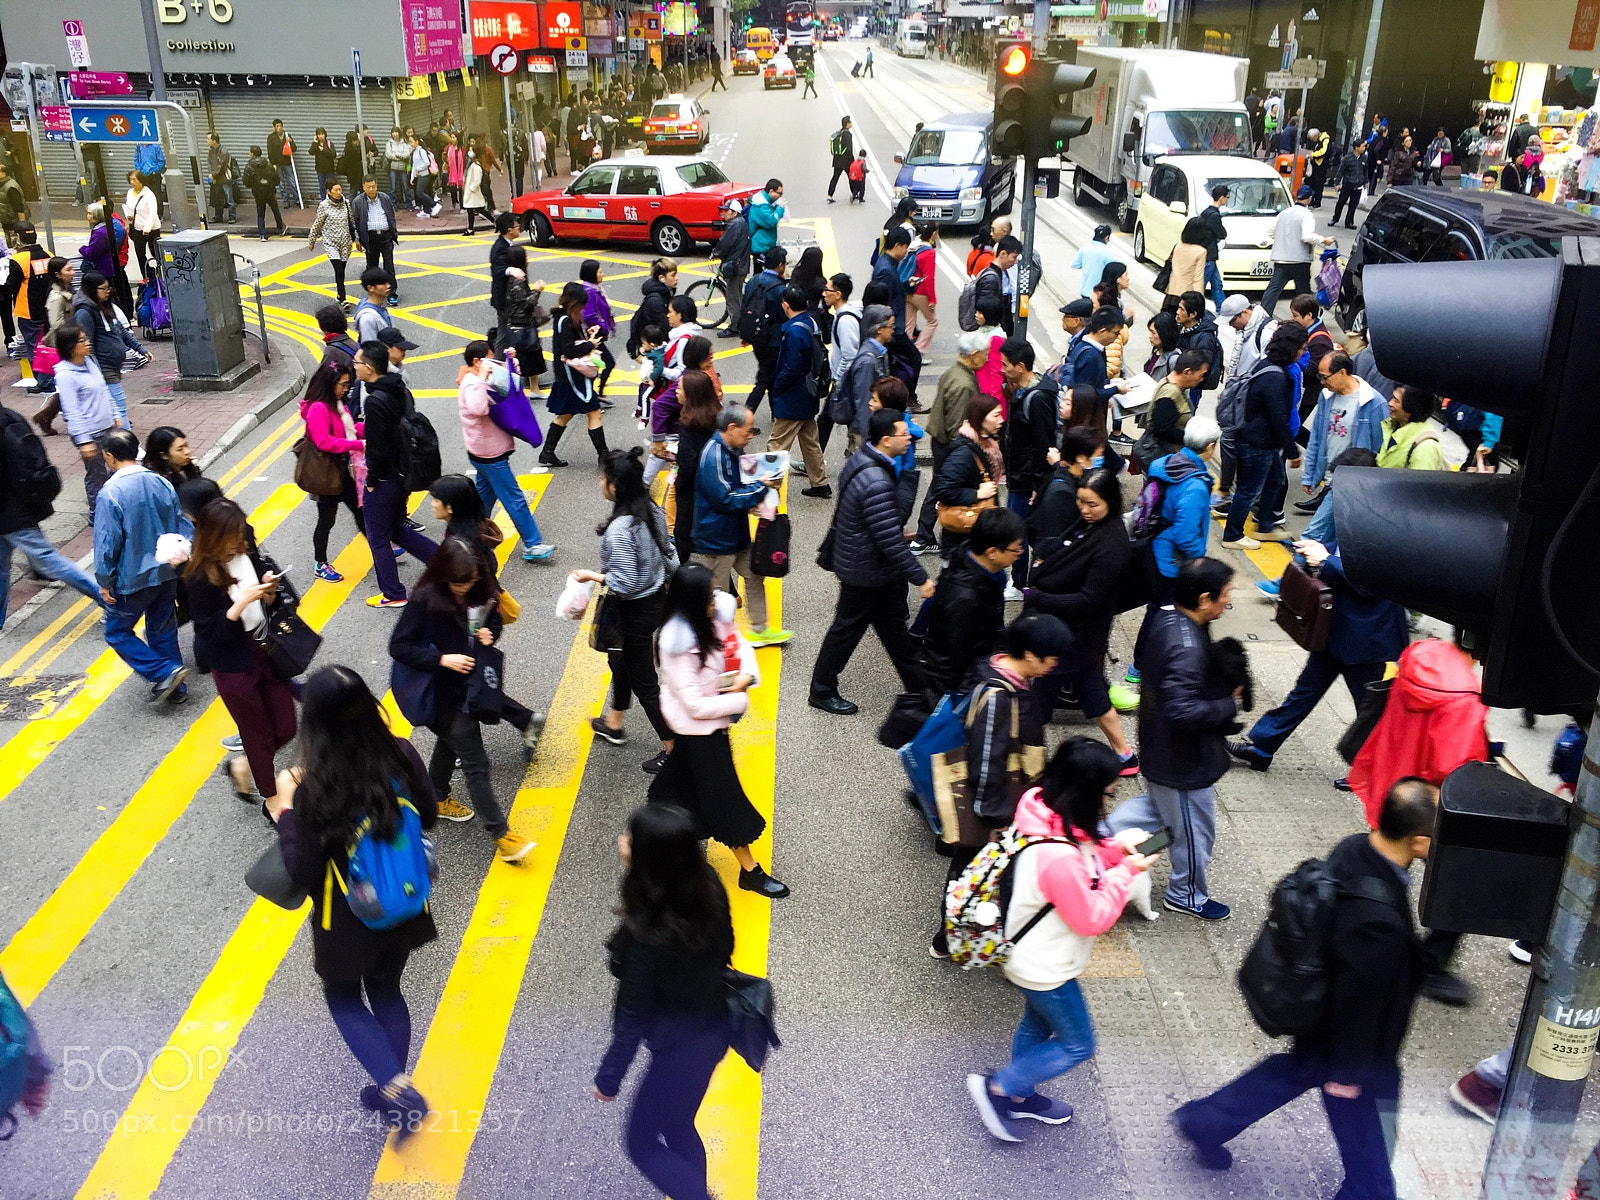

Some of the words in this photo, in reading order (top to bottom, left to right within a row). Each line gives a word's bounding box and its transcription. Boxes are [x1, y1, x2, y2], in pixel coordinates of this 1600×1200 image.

[69, 38, 84, 64] 灣仔
[166, 39, 236, 52] Collection
[570, 57, 585, 65] 全日
[396, 83, 414, 97] $5
[1552, 1043, 1579, 1054] 2333
